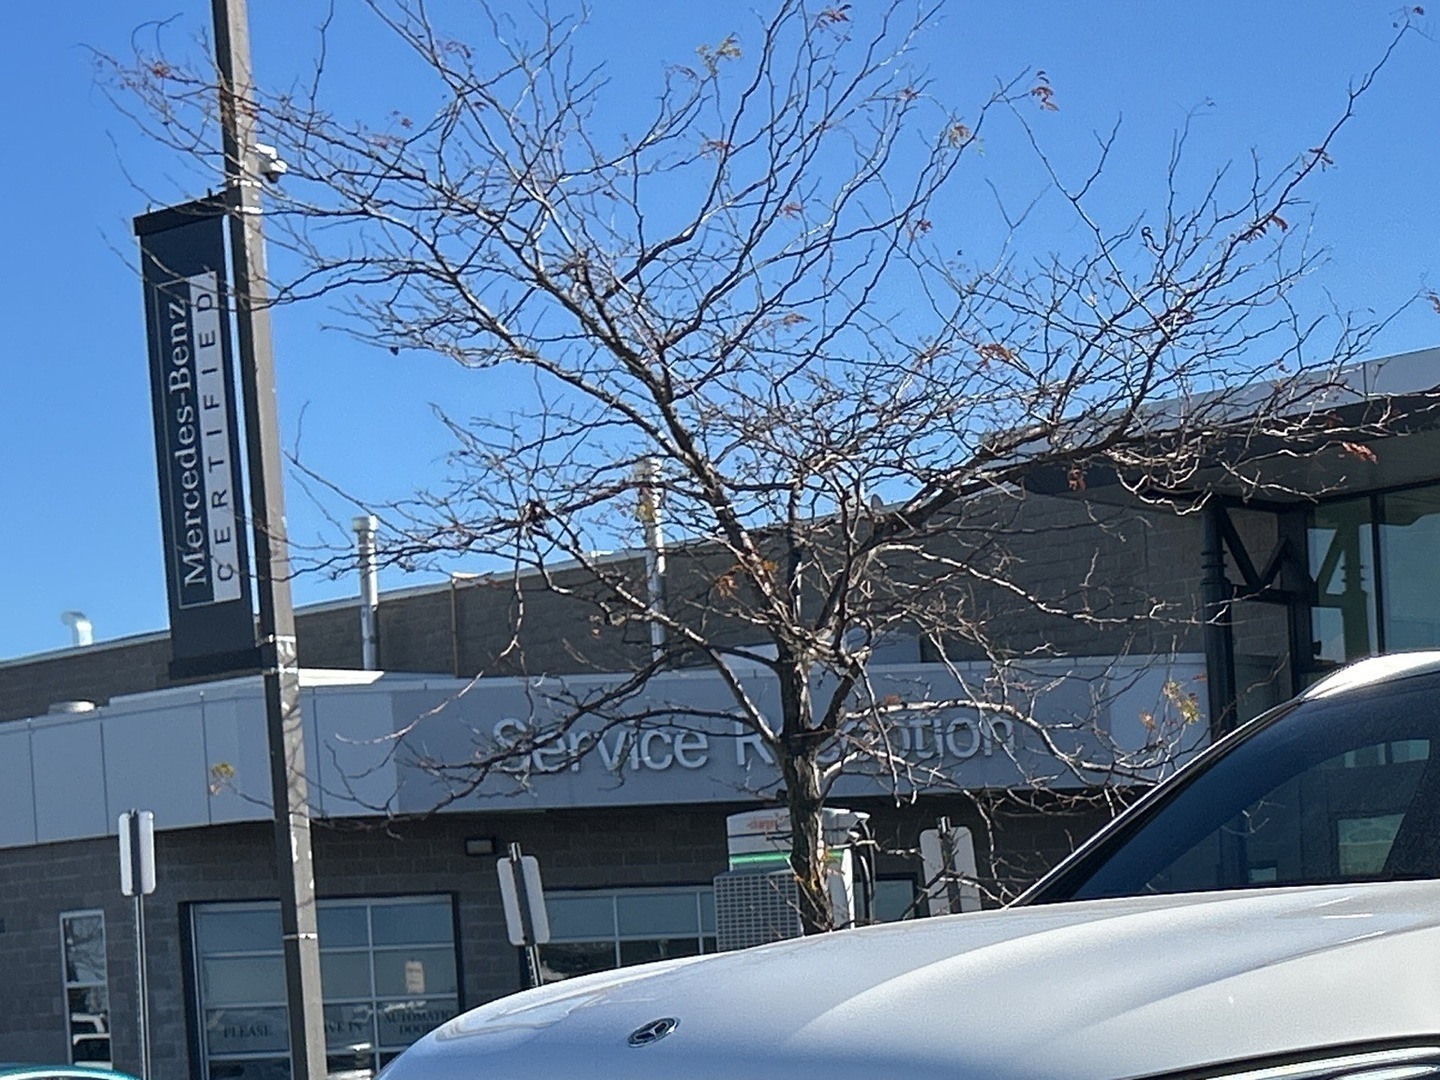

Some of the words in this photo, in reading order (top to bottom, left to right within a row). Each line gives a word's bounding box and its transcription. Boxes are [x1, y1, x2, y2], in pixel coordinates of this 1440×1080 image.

[168, 299, 207, 588] Mercedes-Benz
[197, 293, 235, 582] CERTIFIED
[492, 717, 709, 773] Service
[224, 1025, 272, 1038] PLEASE
